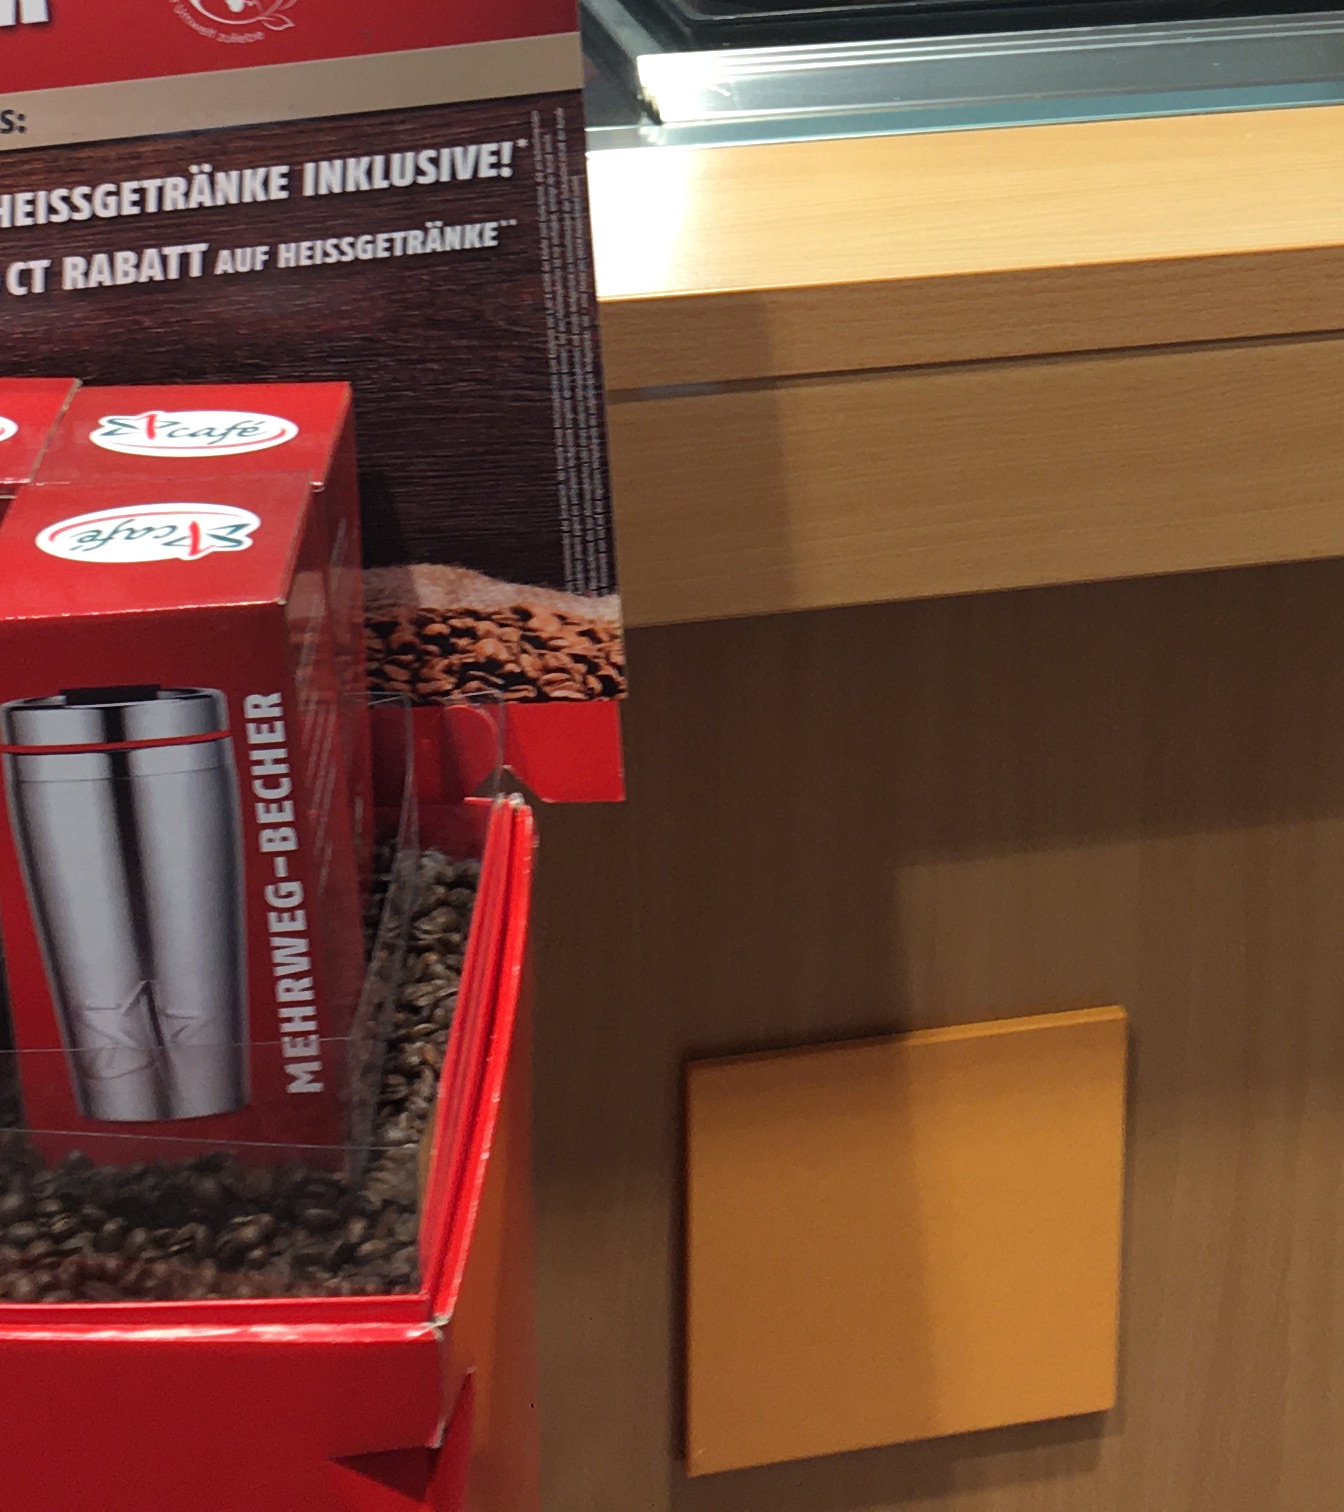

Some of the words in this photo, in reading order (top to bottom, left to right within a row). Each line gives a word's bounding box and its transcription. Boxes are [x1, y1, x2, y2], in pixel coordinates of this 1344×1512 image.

[7, 259, 52, 296] CT
[62, 243, 209, 290] RABATT
[214, 245, 270, 275] AUF
[165, 420, 262, 444] café
[70, 518, 179, 552] café
[244, 692, 325, 1094] MEHRWEG-BECHER
